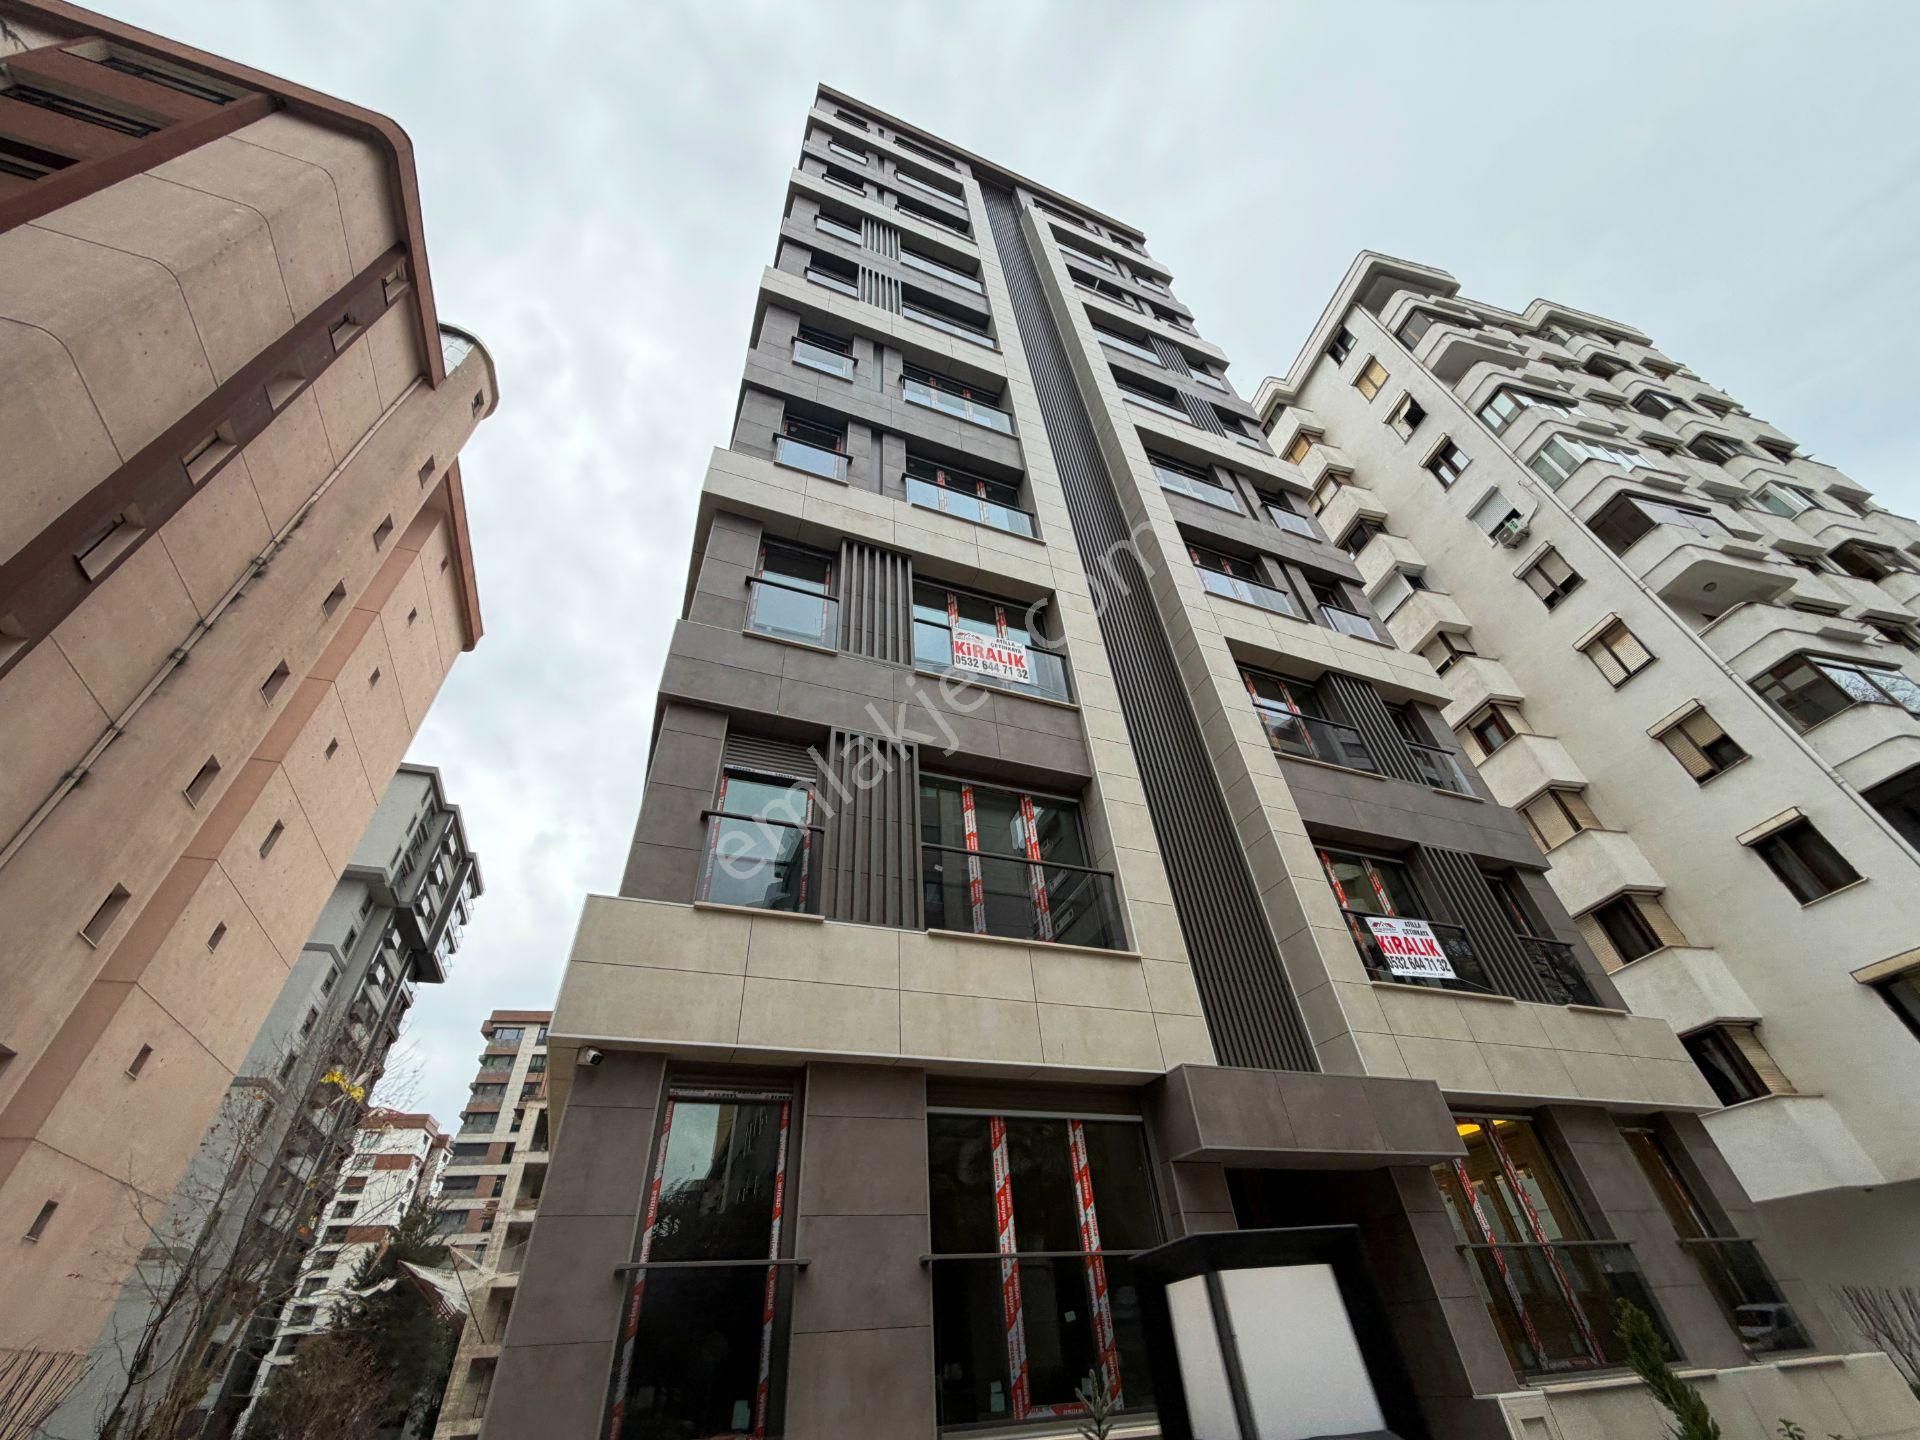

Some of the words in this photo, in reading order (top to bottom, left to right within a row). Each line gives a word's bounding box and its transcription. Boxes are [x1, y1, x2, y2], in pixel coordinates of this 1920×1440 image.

[955, 655, 980, 668] 0532
[982, 660, 1000, 673] 644
[1002, 665, 1013, 676] 71
[1016, 668, 1029, 680] 32
[1386, 956, 1409, 969] 0532
[1407, 957, 1426, 970] 644
[1424, 957, 1438, 971] 71
[1436, 958, 1451, 972] 32
